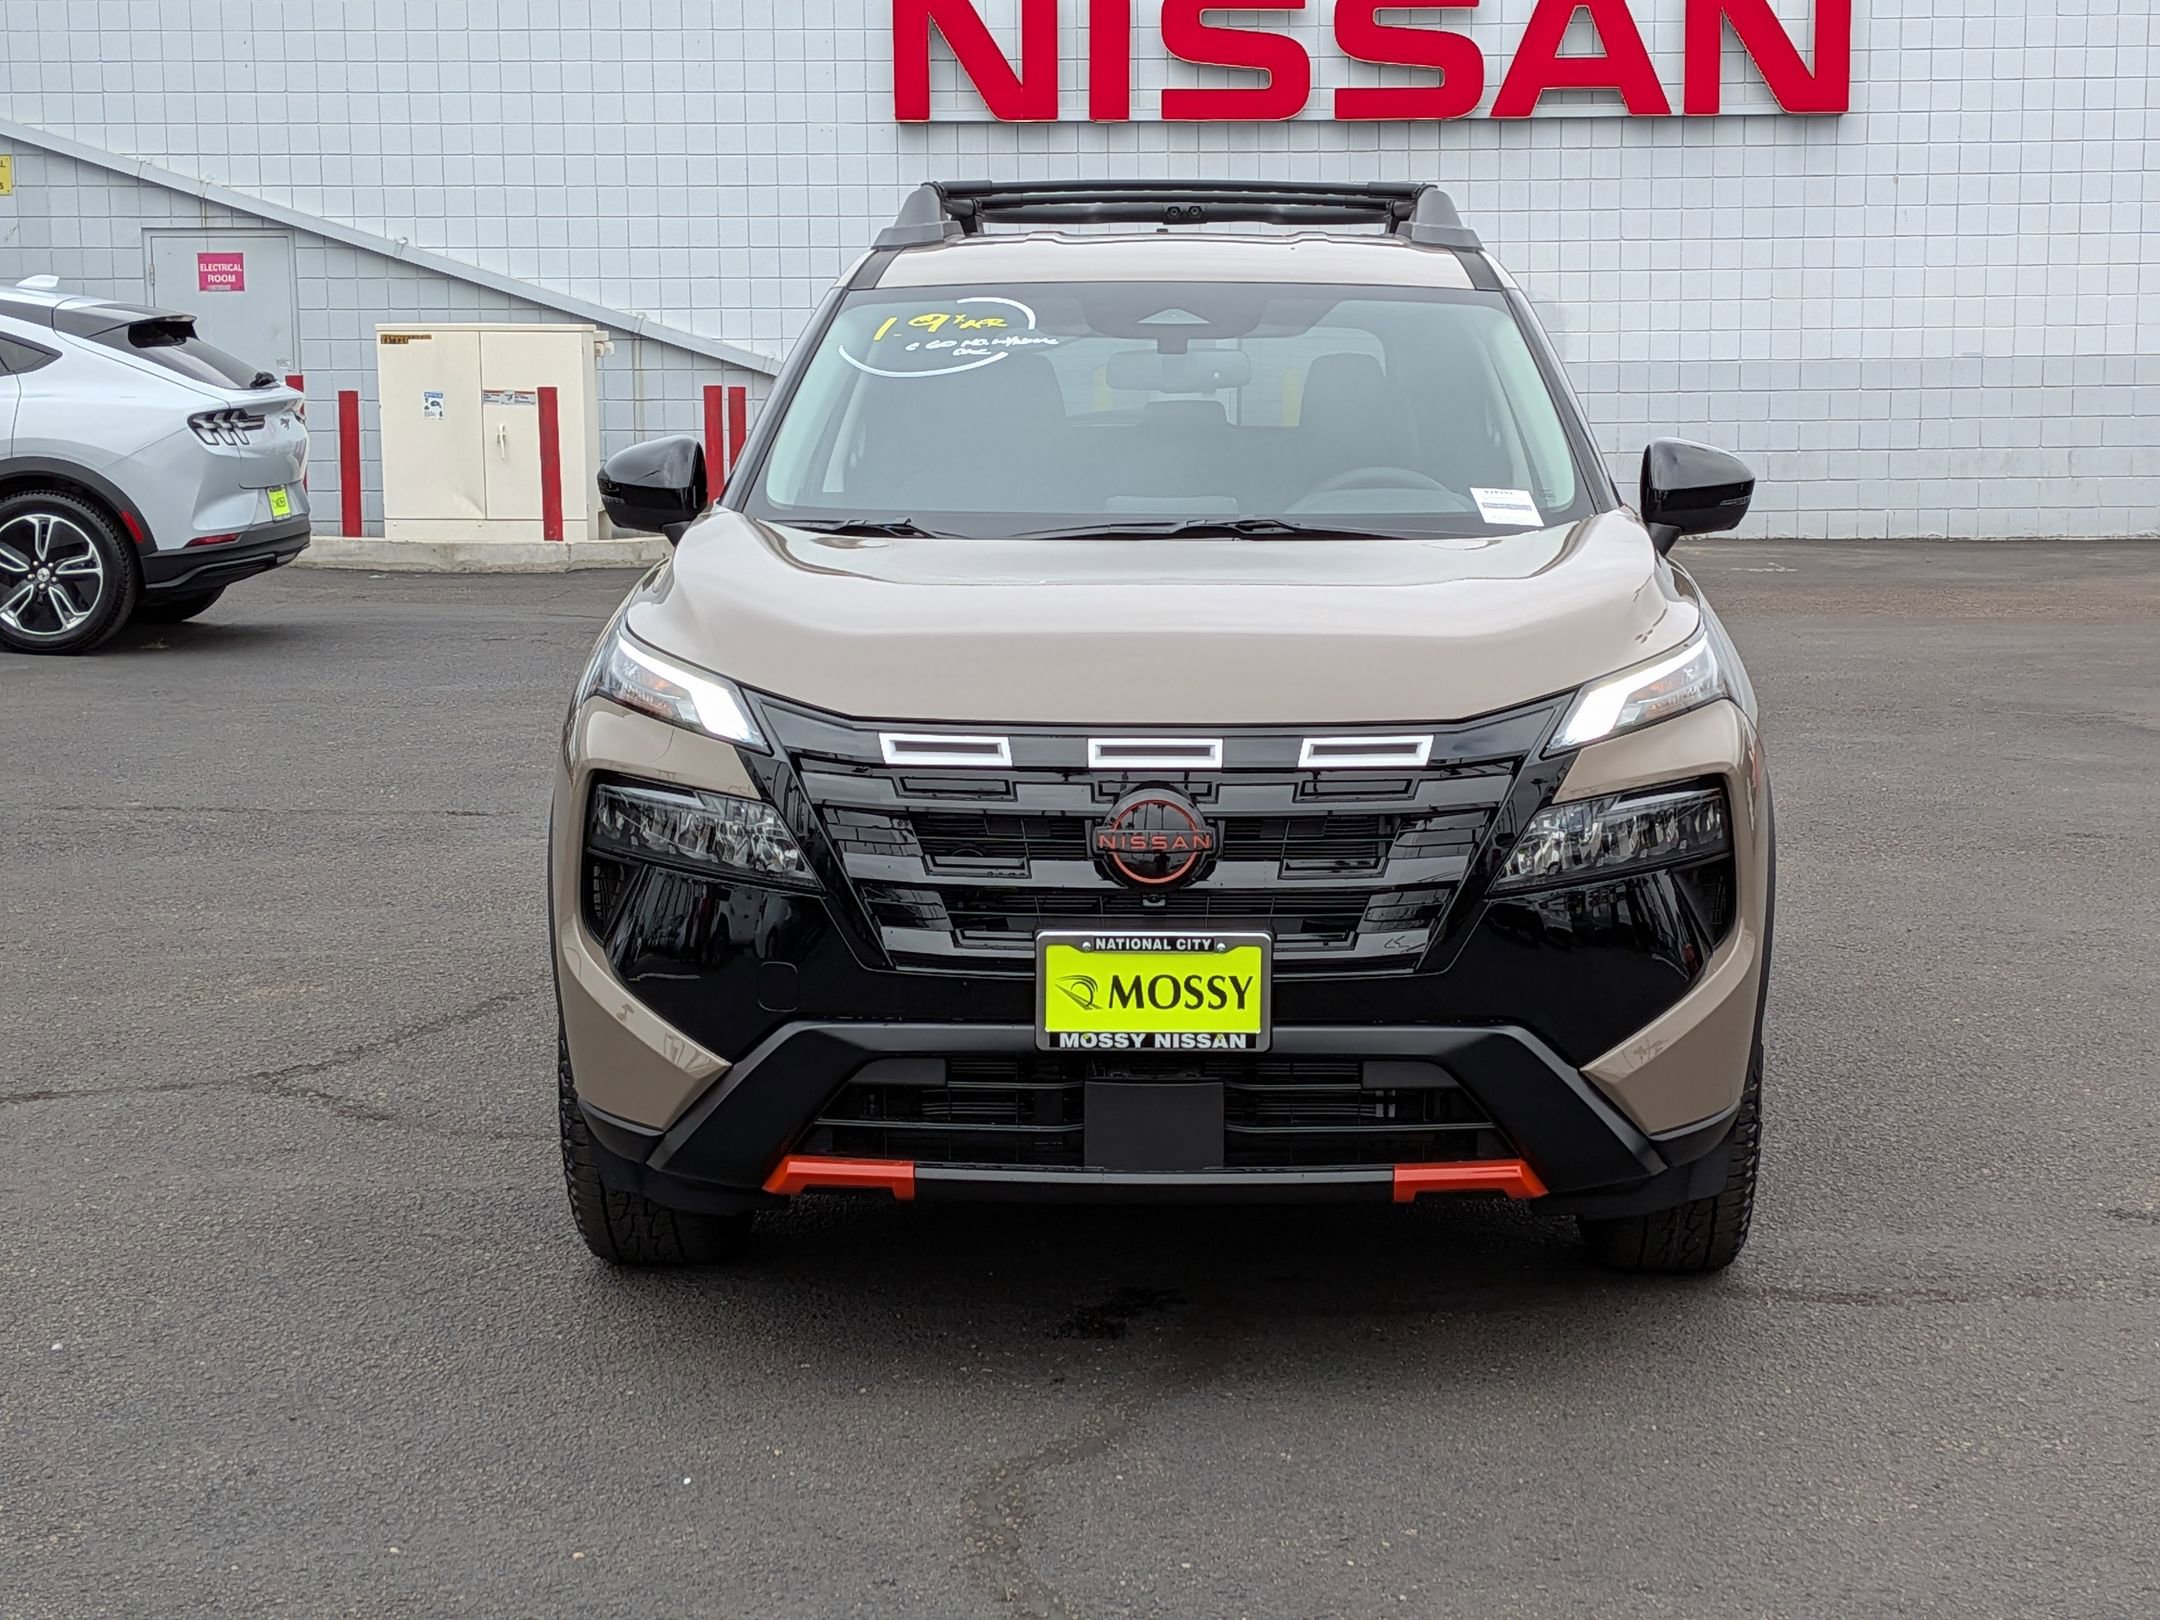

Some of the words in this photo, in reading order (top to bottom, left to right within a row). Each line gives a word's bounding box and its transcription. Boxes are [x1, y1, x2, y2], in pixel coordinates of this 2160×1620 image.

[893, 0, 1850, 122] NISSAN
[200, 263, 243, 272] ELECTRICAL
[207, 274, 237, 283] ROOM
[1098, 834, 1212, 850] NISSAN
[1095, 938, 1171, 950] NATIONAL
[1176, 938, 1212, 950] CITY
[1108, 974, 1254, 1010] MOSSY
[1059, 1032, 1148, 1048] MOSSY
[1154, 1033, 1246, 1048] NISSAN
